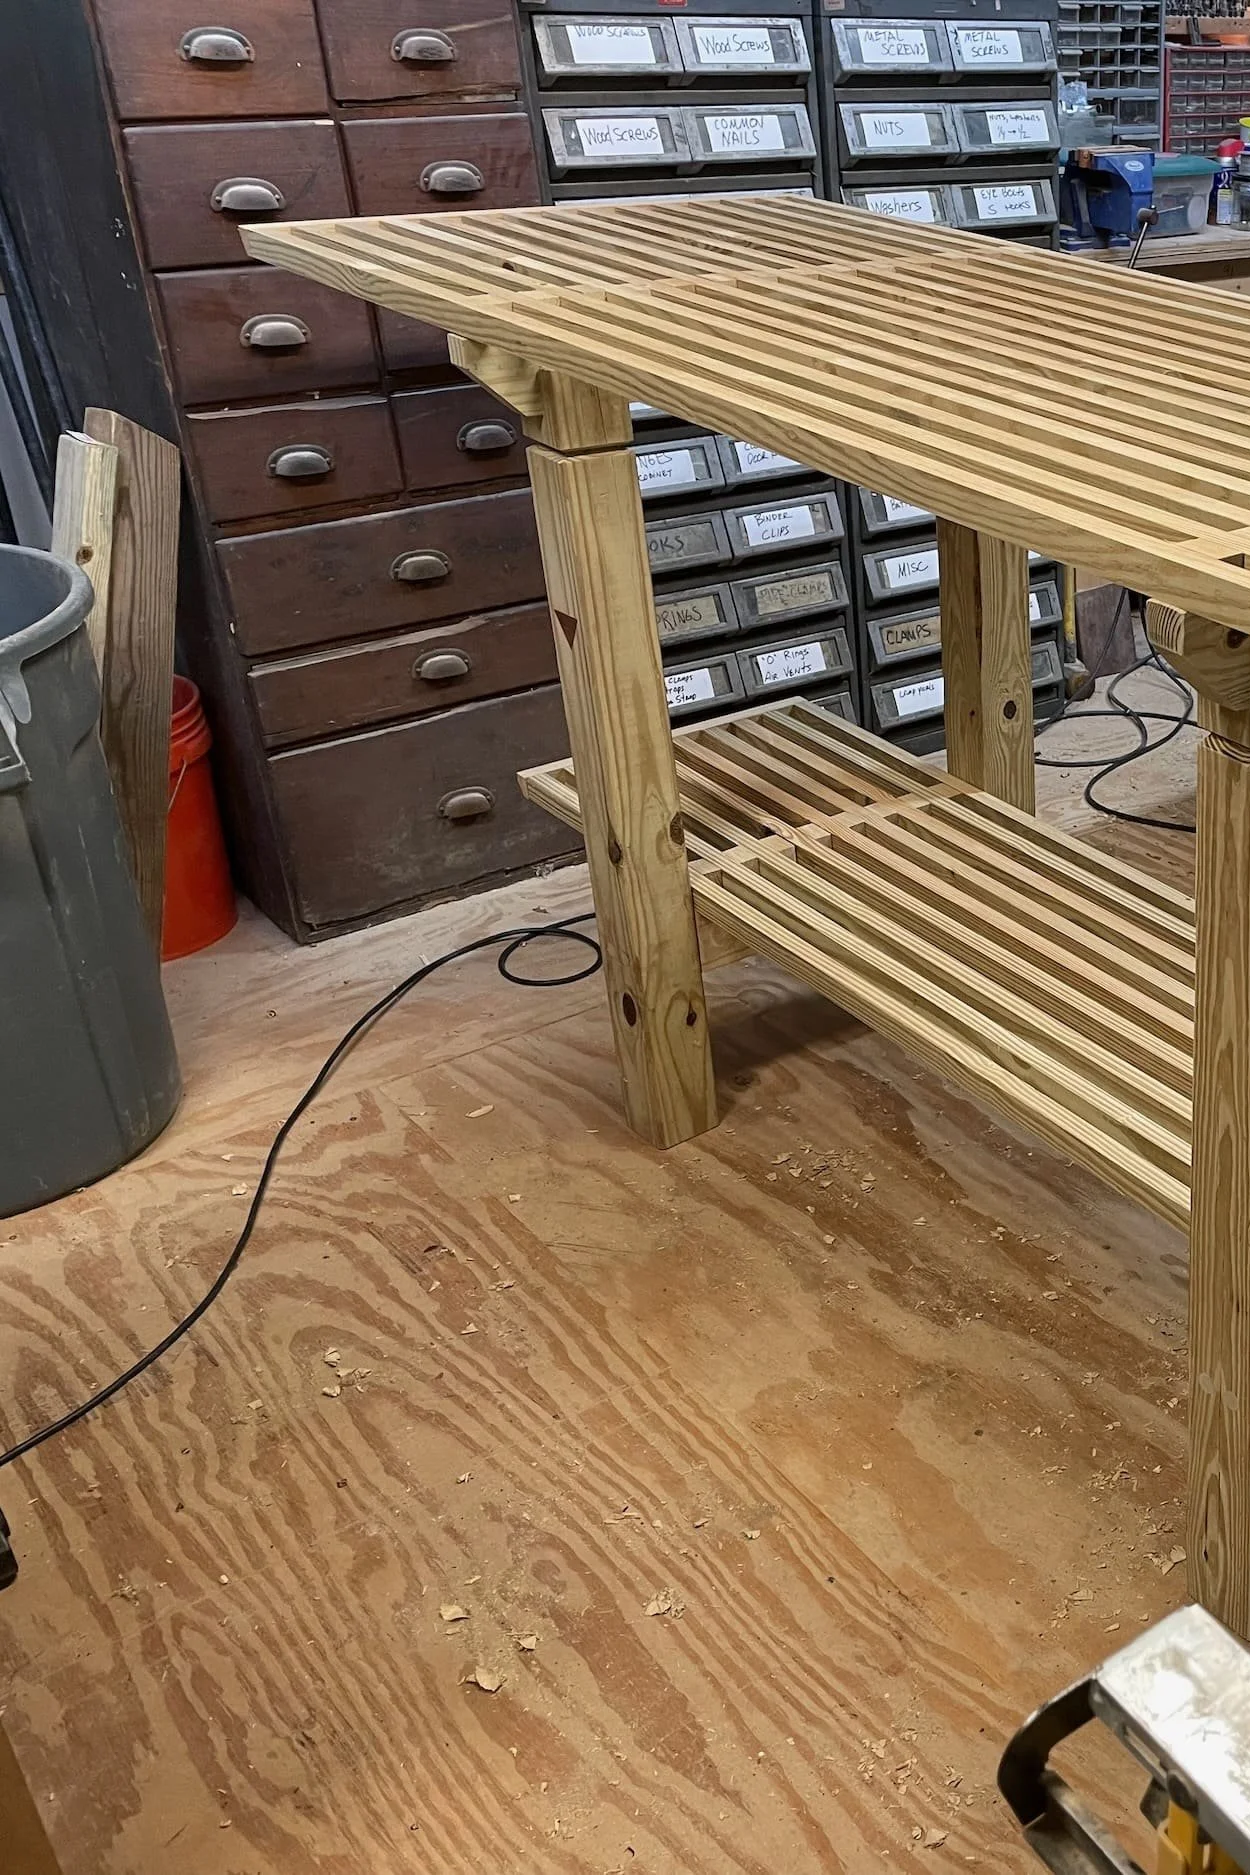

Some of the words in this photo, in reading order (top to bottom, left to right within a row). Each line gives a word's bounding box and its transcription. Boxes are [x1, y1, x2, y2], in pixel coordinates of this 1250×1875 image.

[864, 31, 904, 43] METAL
[964, 32, 1000, 43] METAL
[881, 42, 927, 56] SCREWS
[972, 44, 1009, 58] SCREWS
[714, 116, 764, 129] COMMON
[874, 119, 904, 137] NUTS
[721, 130, 760, 146] NAILS
[870, 198, 922, 216] Washers
[754, 511, 793, 526] BINDER
[762, 525, 791, 541] CLIPS
[649, 535, 685, 551] OKS
[898, 561, 928, 578] MISC
[656, 605, 702, 631] PRINGS
[886, 624, 932, 644] CLAMPS
